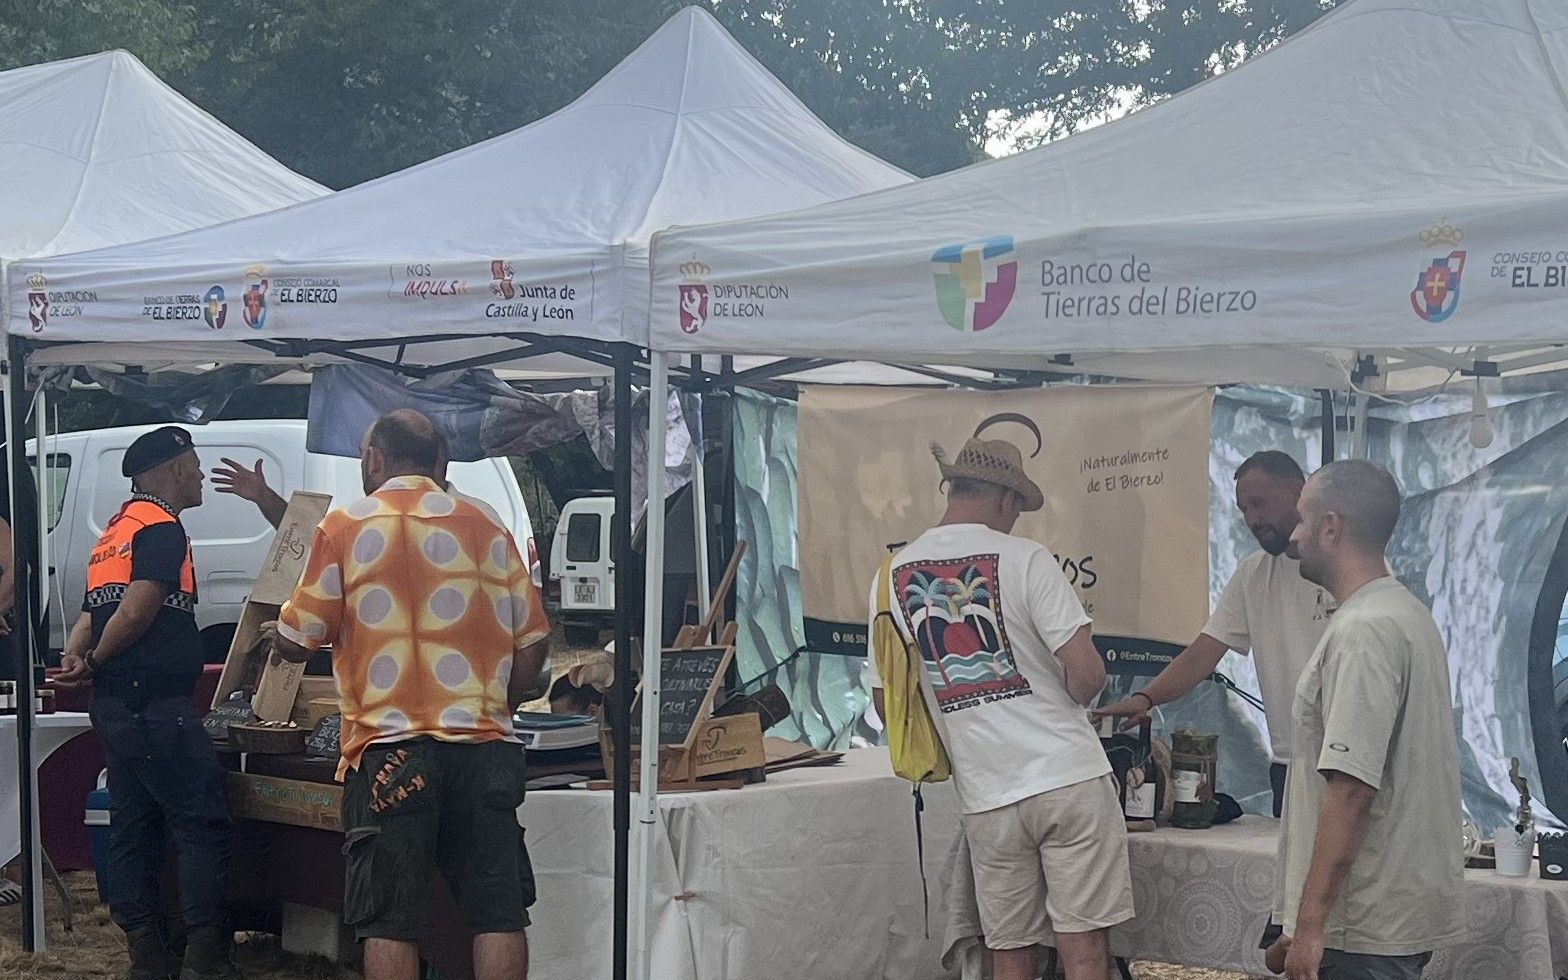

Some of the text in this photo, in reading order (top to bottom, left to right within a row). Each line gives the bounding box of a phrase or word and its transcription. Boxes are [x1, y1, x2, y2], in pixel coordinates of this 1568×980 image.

[1493, 251, 1552, 265] CONSEJO
[406, 263, 432, 277] NOS
[1040, 254, 1151, 287] Banco de
[1490, 266, 1507, 278] DE
[1511, 266, 1540, 288] EL
[280, 287, 295, 303] EL
[296, 287, 338, 304] BIERZO
[519, 283, 576, 301] Junta de
[713, 302, 729, 317] DE
[1040, 285, 1258, 319] Tierras del Bierzo
[153, 305, 165, 320] EL
[166, 305, 201, 320] BIERZO
[485, 302, 529, 319] Castilla
[531, 306, 539, 322] y
[1087, 477, 1101, 494] de
[1104, 475, 1116, 492] El
